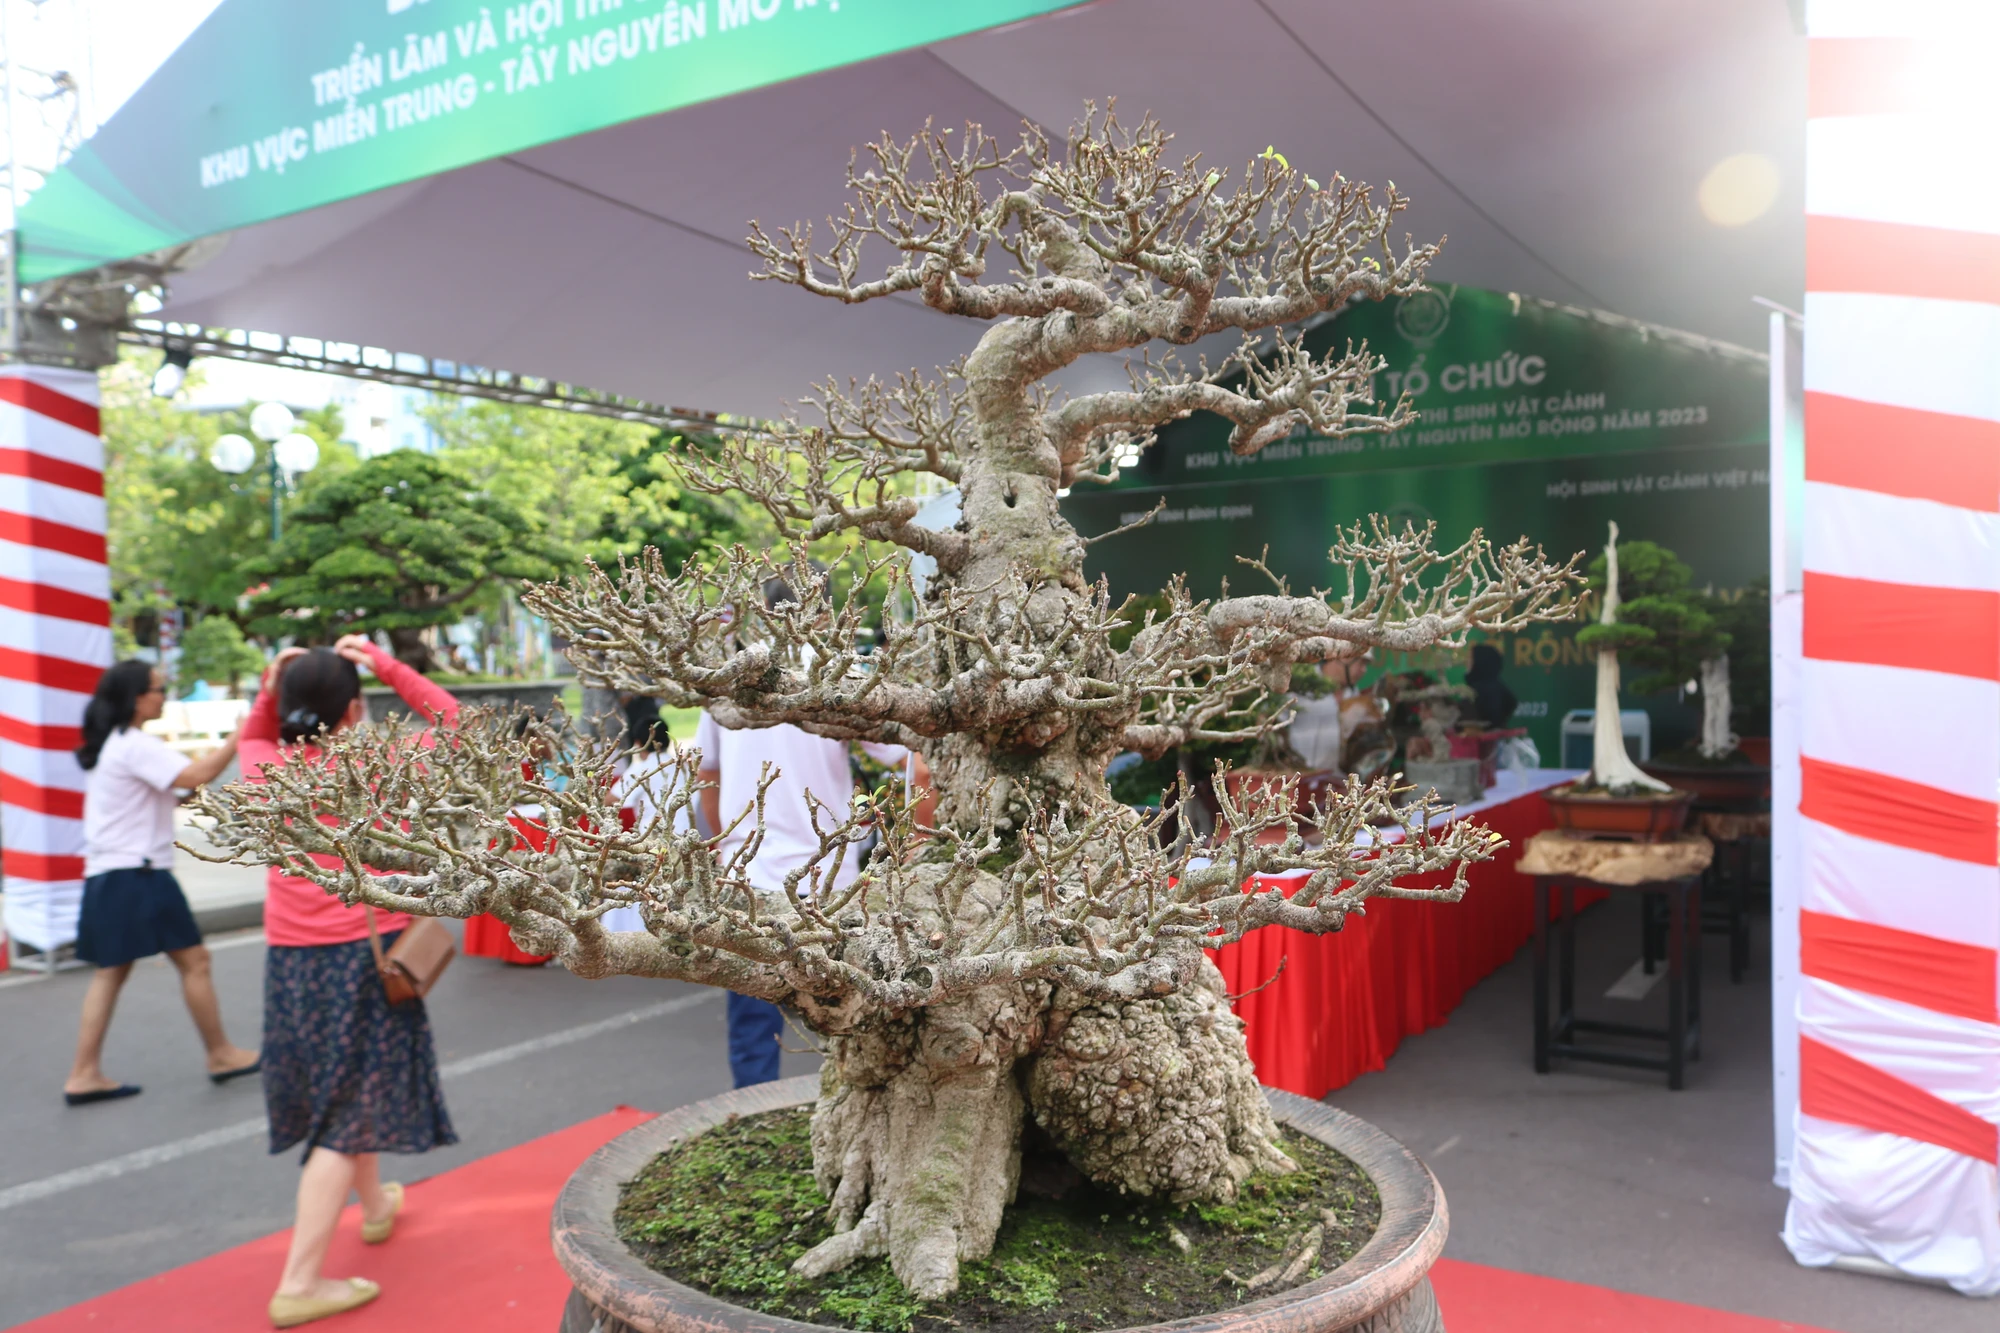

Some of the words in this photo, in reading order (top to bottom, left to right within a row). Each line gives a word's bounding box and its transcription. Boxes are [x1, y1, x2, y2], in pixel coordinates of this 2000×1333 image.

[310, 41, 383, 106] TRIỂN
[453, 7, 499, 57] VÀ
[200, 145, 250, 188] KHU
[253, 126, 309, 174] VỰC
[312, 95, 378, 153] MIỀN
[381, 72, 478, 131] TRUNG
[500, 44, 560, 94] TÂY
[567, 0, 707, 76] NGUYÊN
[1385, 353, 1430, 397] TỔ
[1440, 350, 1548, 393] CHỨC
[1185, 452, 1219, 469] KHU
[1307, 437, 1364, 457] TRUNG
[1417, 421, 1494, 446] NGUYÊN
[1537, 413, 1597, 439] RỘNG
[1656, 406, 1709, 427] 2023
[1453, 403, 1498, 422] SINH
[1580, 477, 1619, 496] SINH
